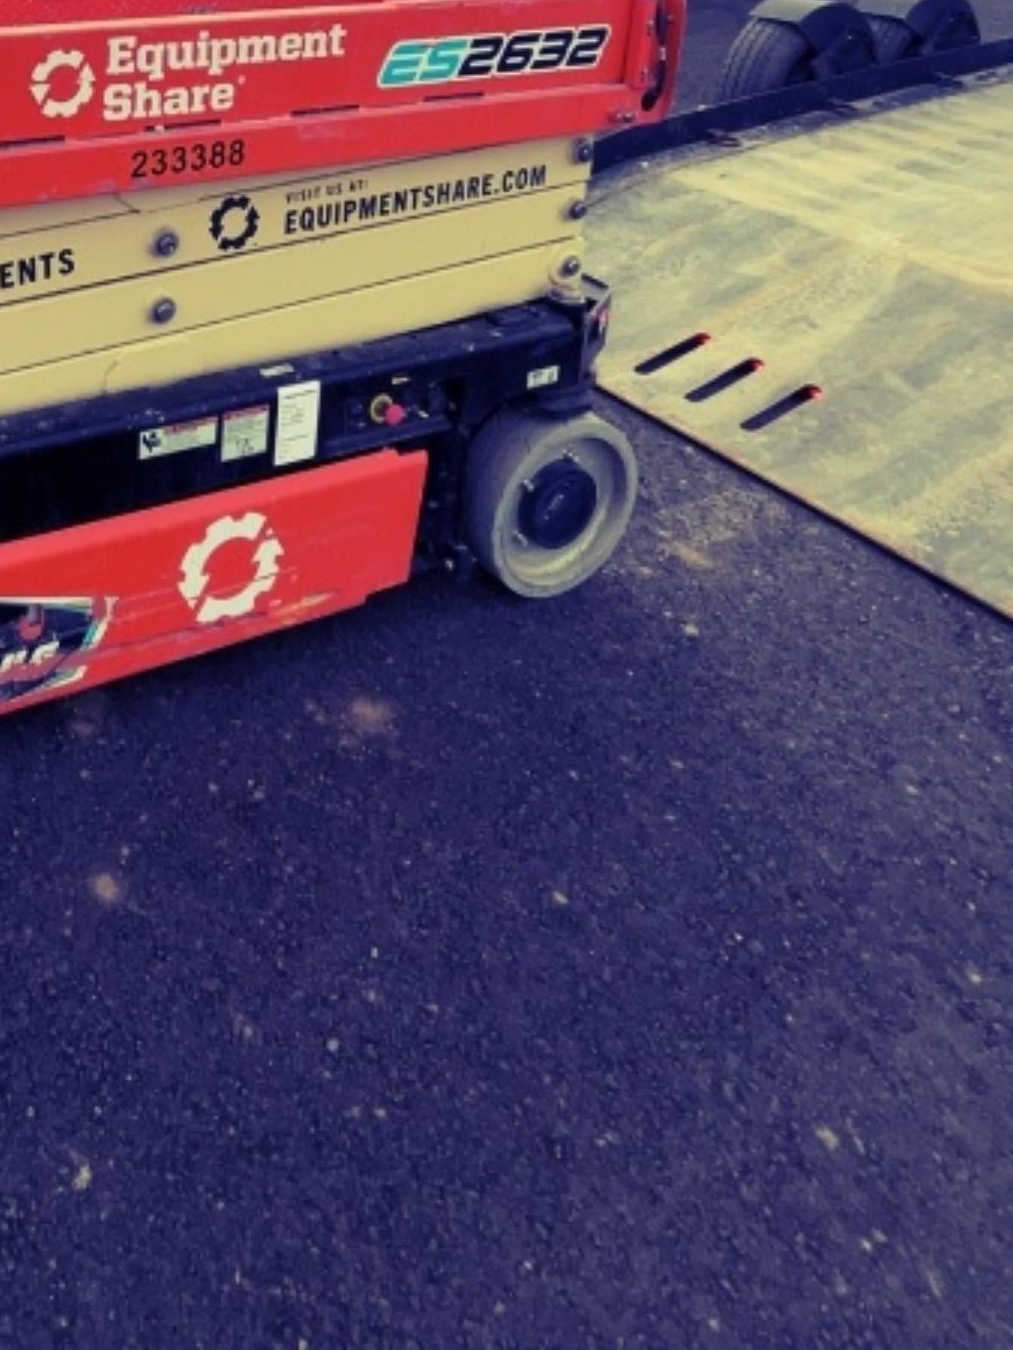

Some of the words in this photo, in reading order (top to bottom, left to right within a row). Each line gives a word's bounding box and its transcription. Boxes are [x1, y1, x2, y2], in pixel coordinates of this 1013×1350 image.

[107, 24, 346, 76] Equipment
[378, 26, 610, 87] ES2632
[103, 80, 235, 121] Share
[130, 140, 246, 179] 233388
[284, 165, 547, 234] EQUIPMENTSHARE.COM
